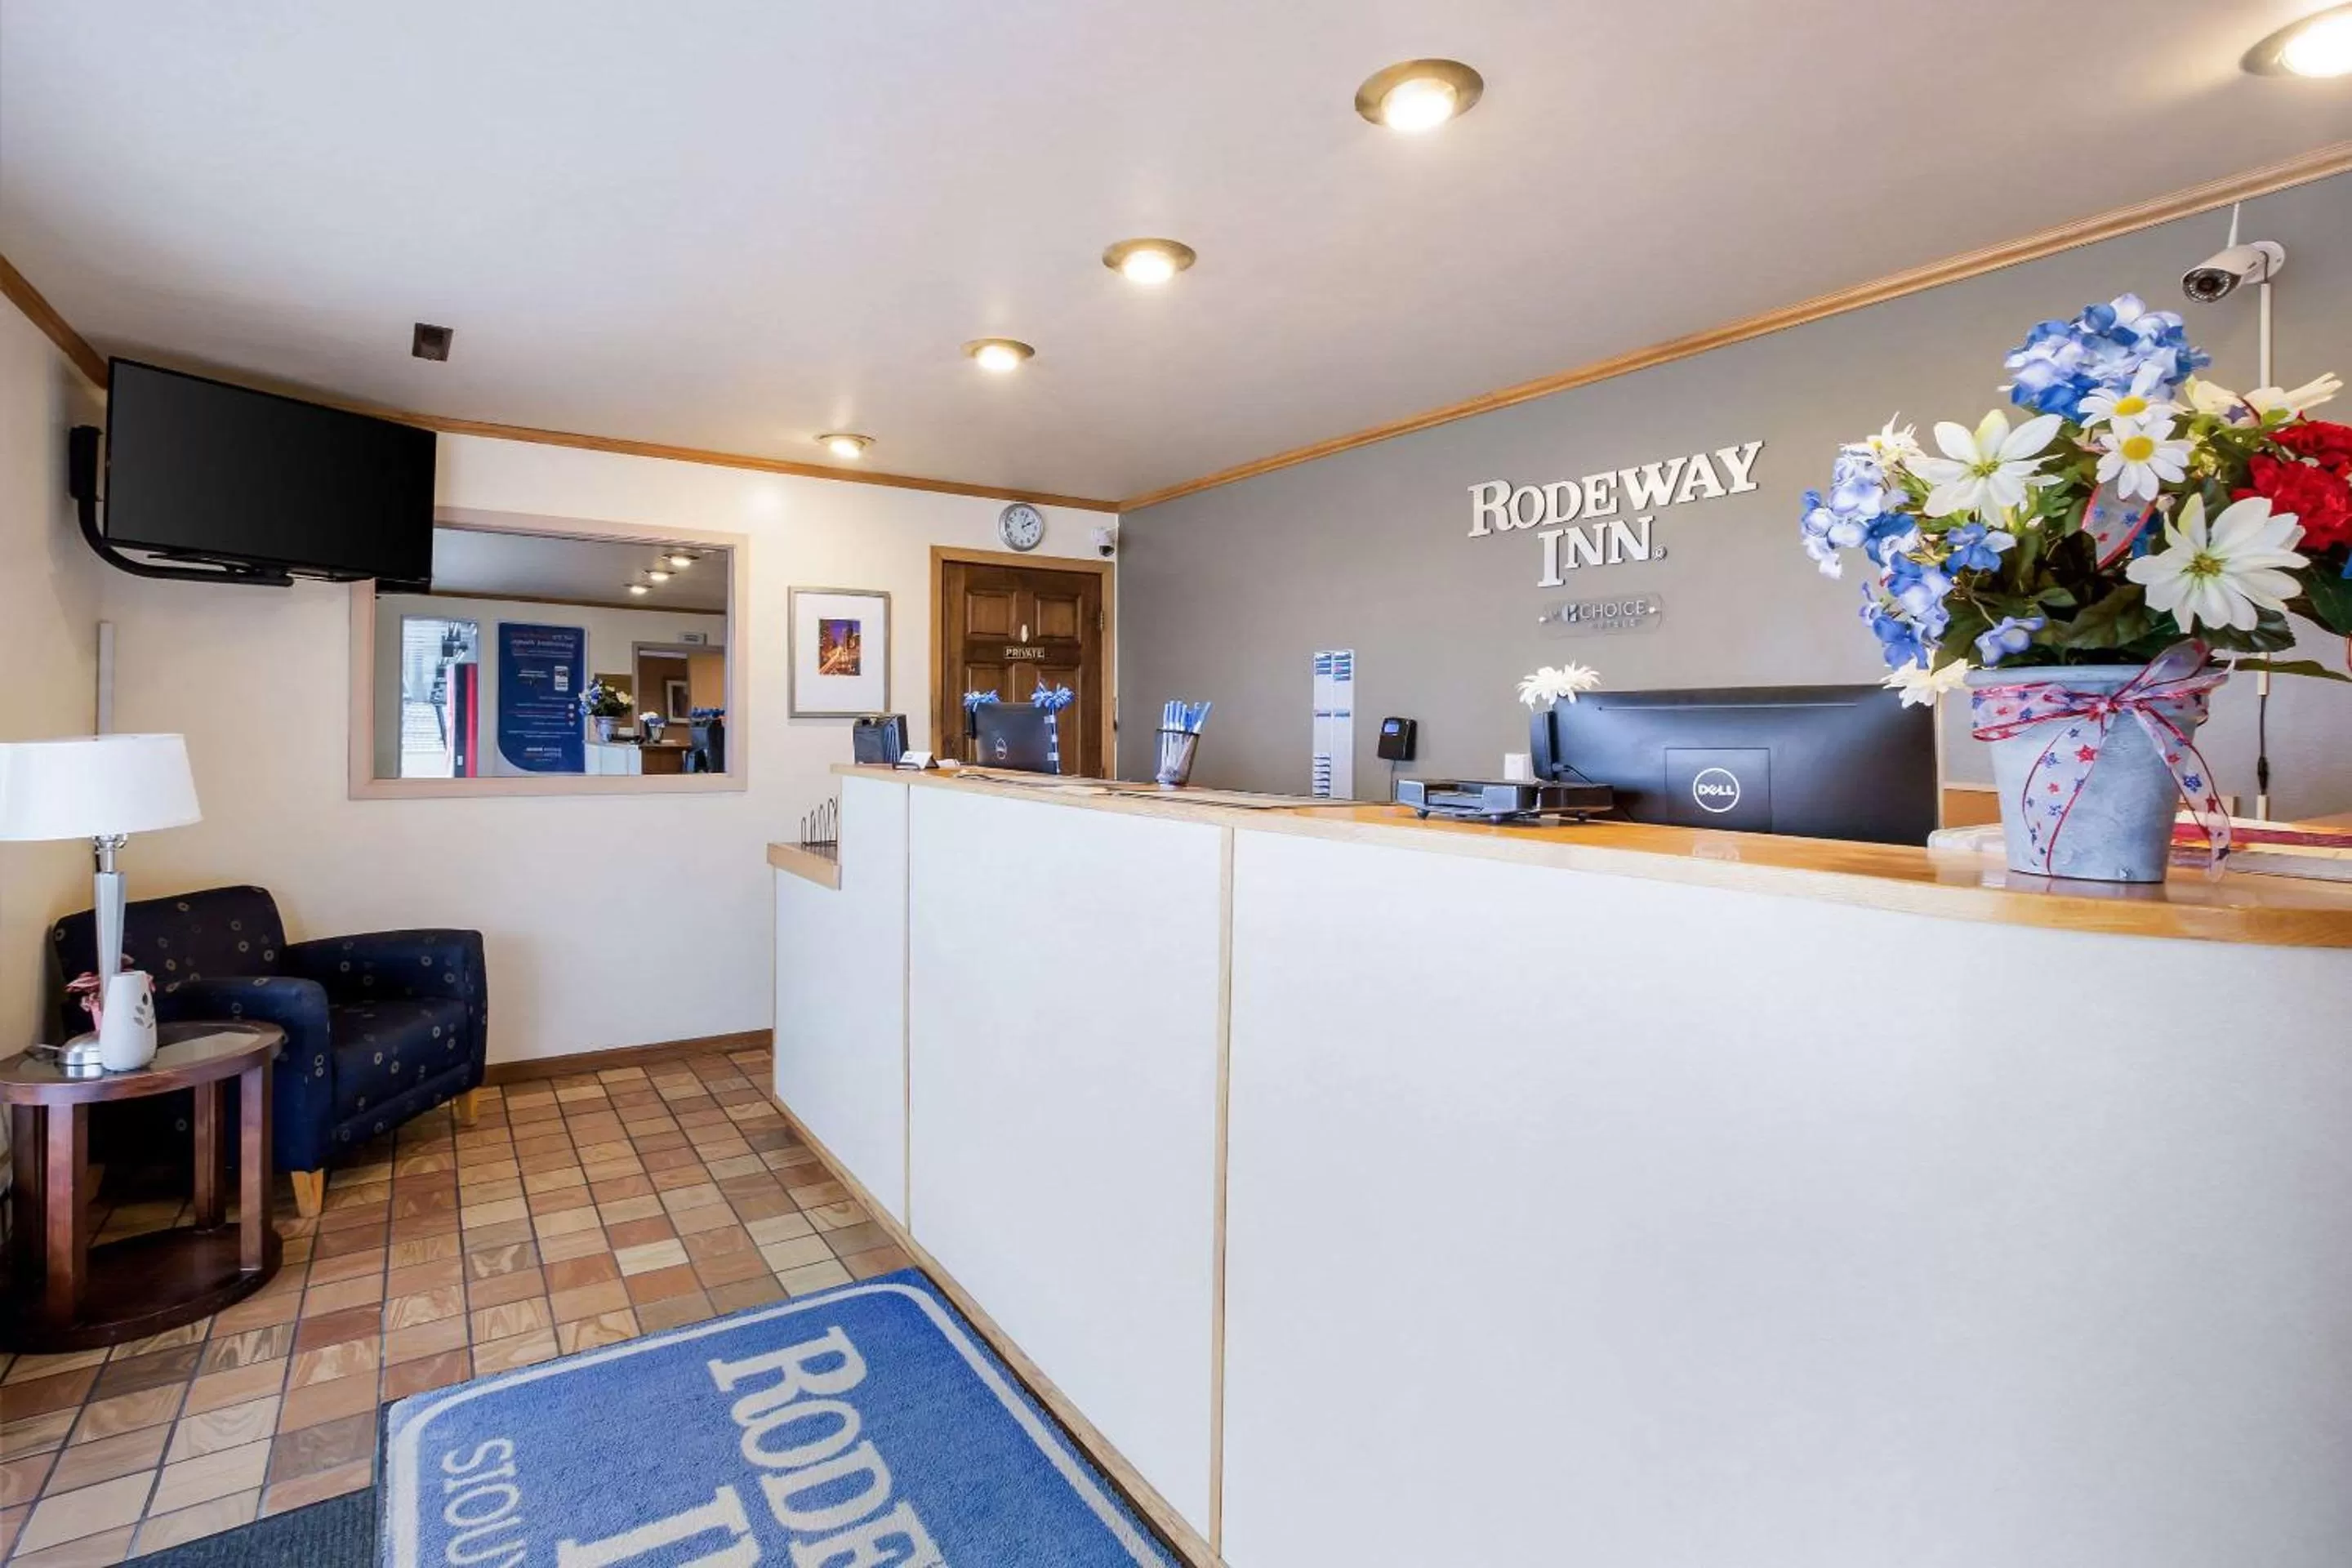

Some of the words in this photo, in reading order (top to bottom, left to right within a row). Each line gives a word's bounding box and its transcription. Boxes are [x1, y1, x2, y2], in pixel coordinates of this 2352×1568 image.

[1468, 439, 1765, 537] RODEWAY
[1580, 600, 1646, 619] CHOICE
[1005, 648, 1045, 658] PRIVATE
[1698, 784, 1735, 795] DELL
[442, 1437, 527, 1568] SIOU
